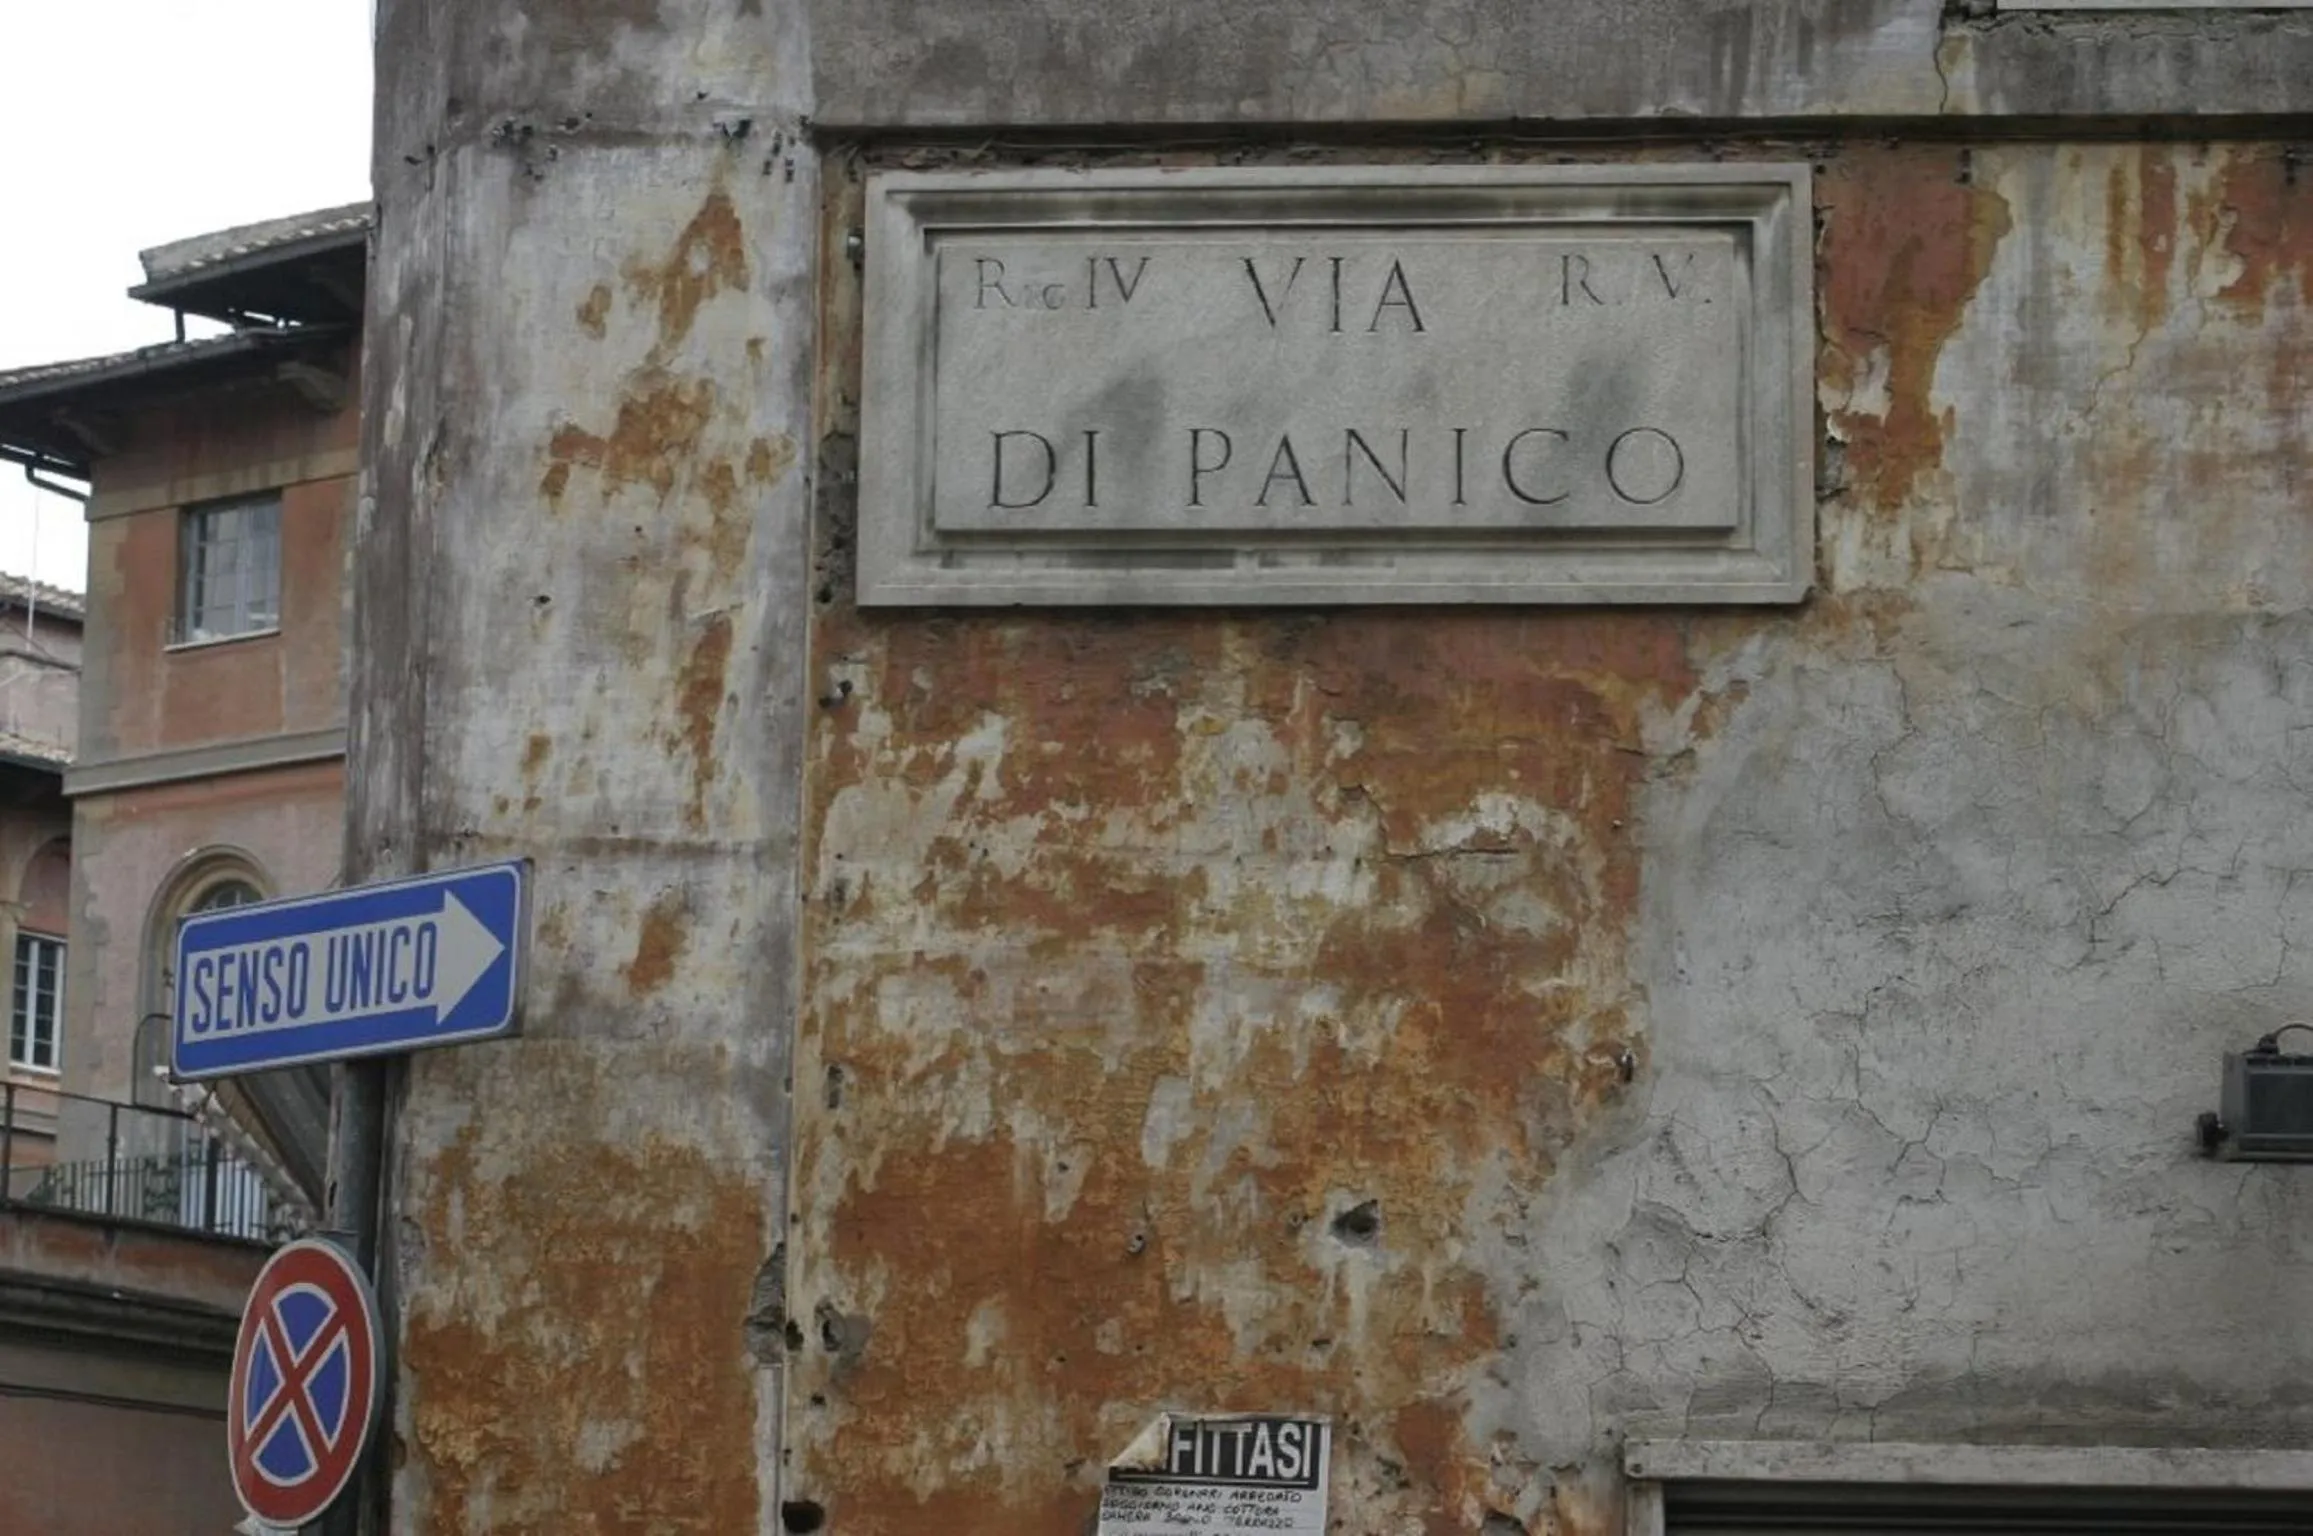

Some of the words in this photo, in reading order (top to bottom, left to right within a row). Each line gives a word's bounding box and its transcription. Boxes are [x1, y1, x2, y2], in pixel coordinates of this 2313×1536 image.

[1086, 256, 1151, 309] IV
[1241, 256, 1428, 335] VIA
[986, 429, 1101, 510] DI
[1186, 426, 1685, 508] PANICO
[191, 941, 310, 1034] SENSO
[324, 920, 438, 1014] UNICO
[1170, 1420, 1312, 1479] FITTASI
